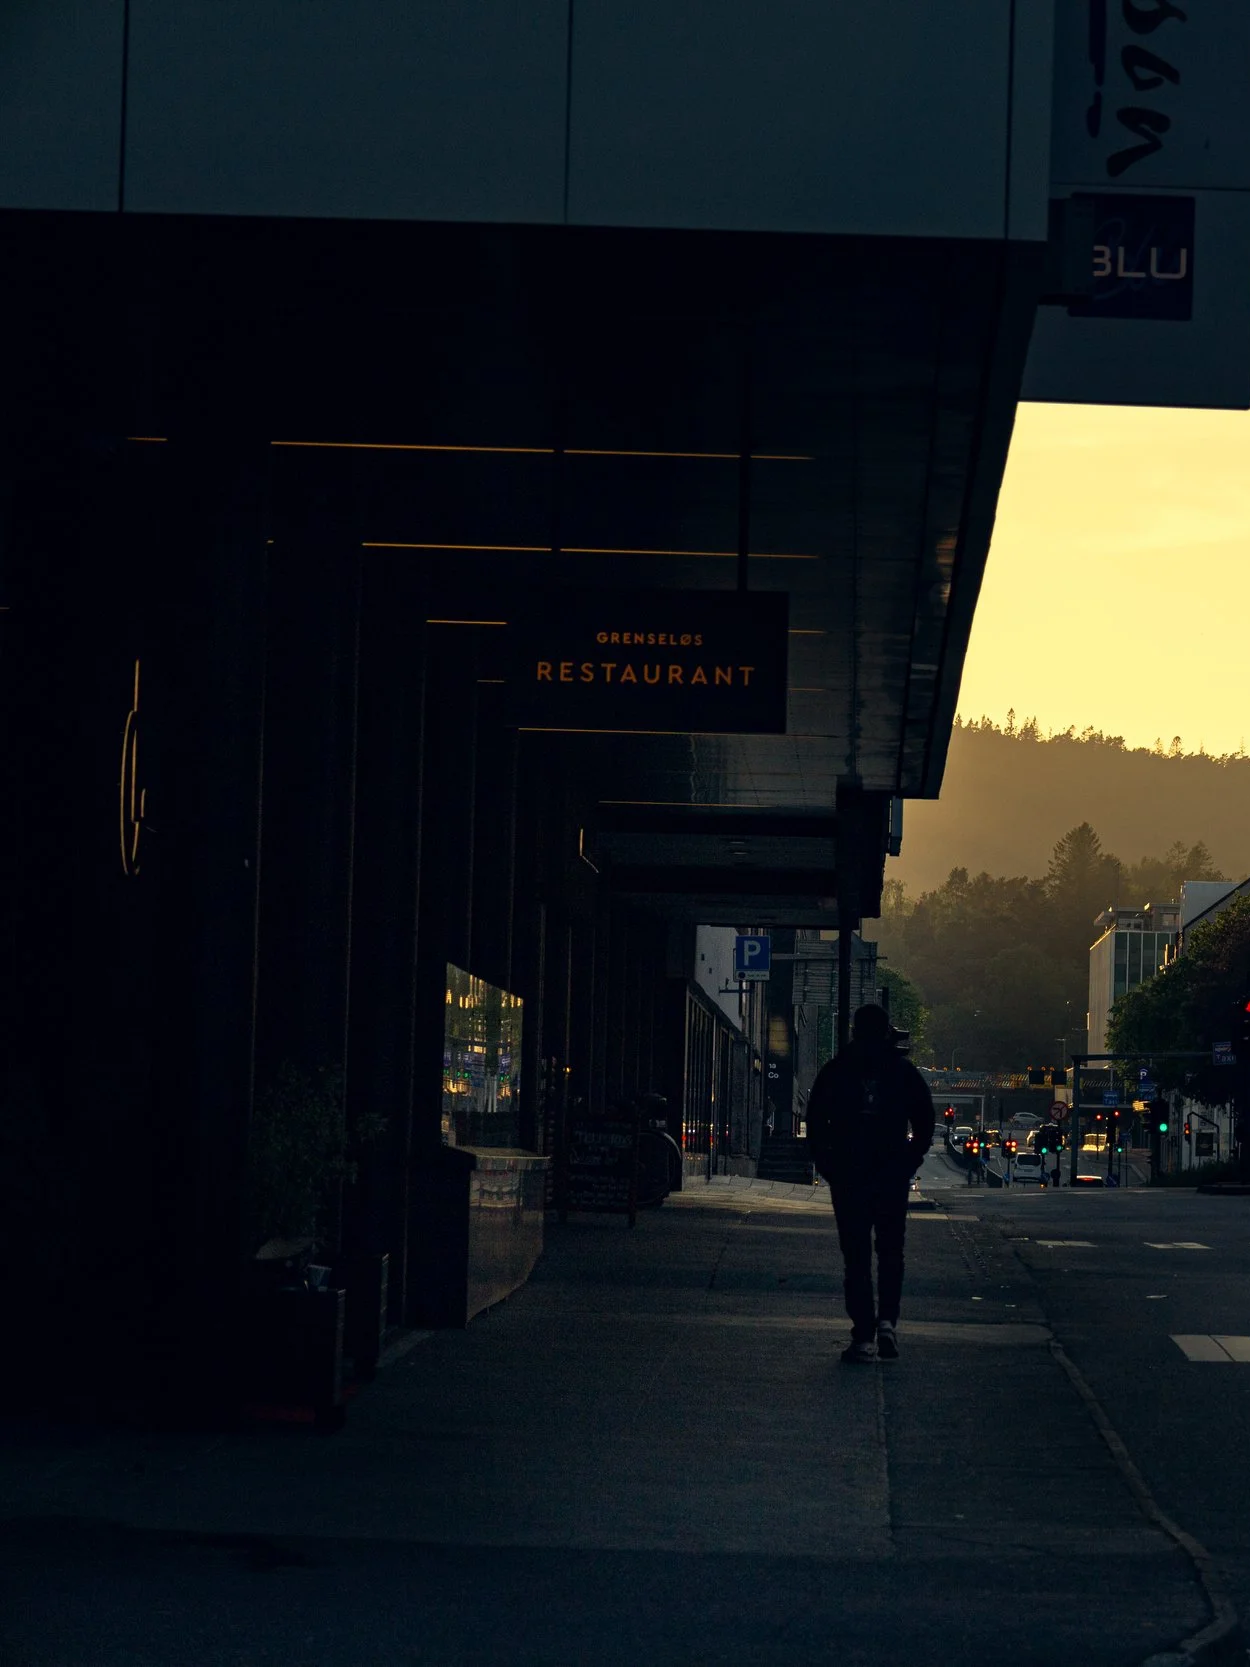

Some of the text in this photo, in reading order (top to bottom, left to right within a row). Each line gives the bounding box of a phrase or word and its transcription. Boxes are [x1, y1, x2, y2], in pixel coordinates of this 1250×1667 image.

[595, 630, 704, 647] GRENSELØS
[536, 660, 756, 687] RESTAURANT
[743, 939, 761, 967] P
